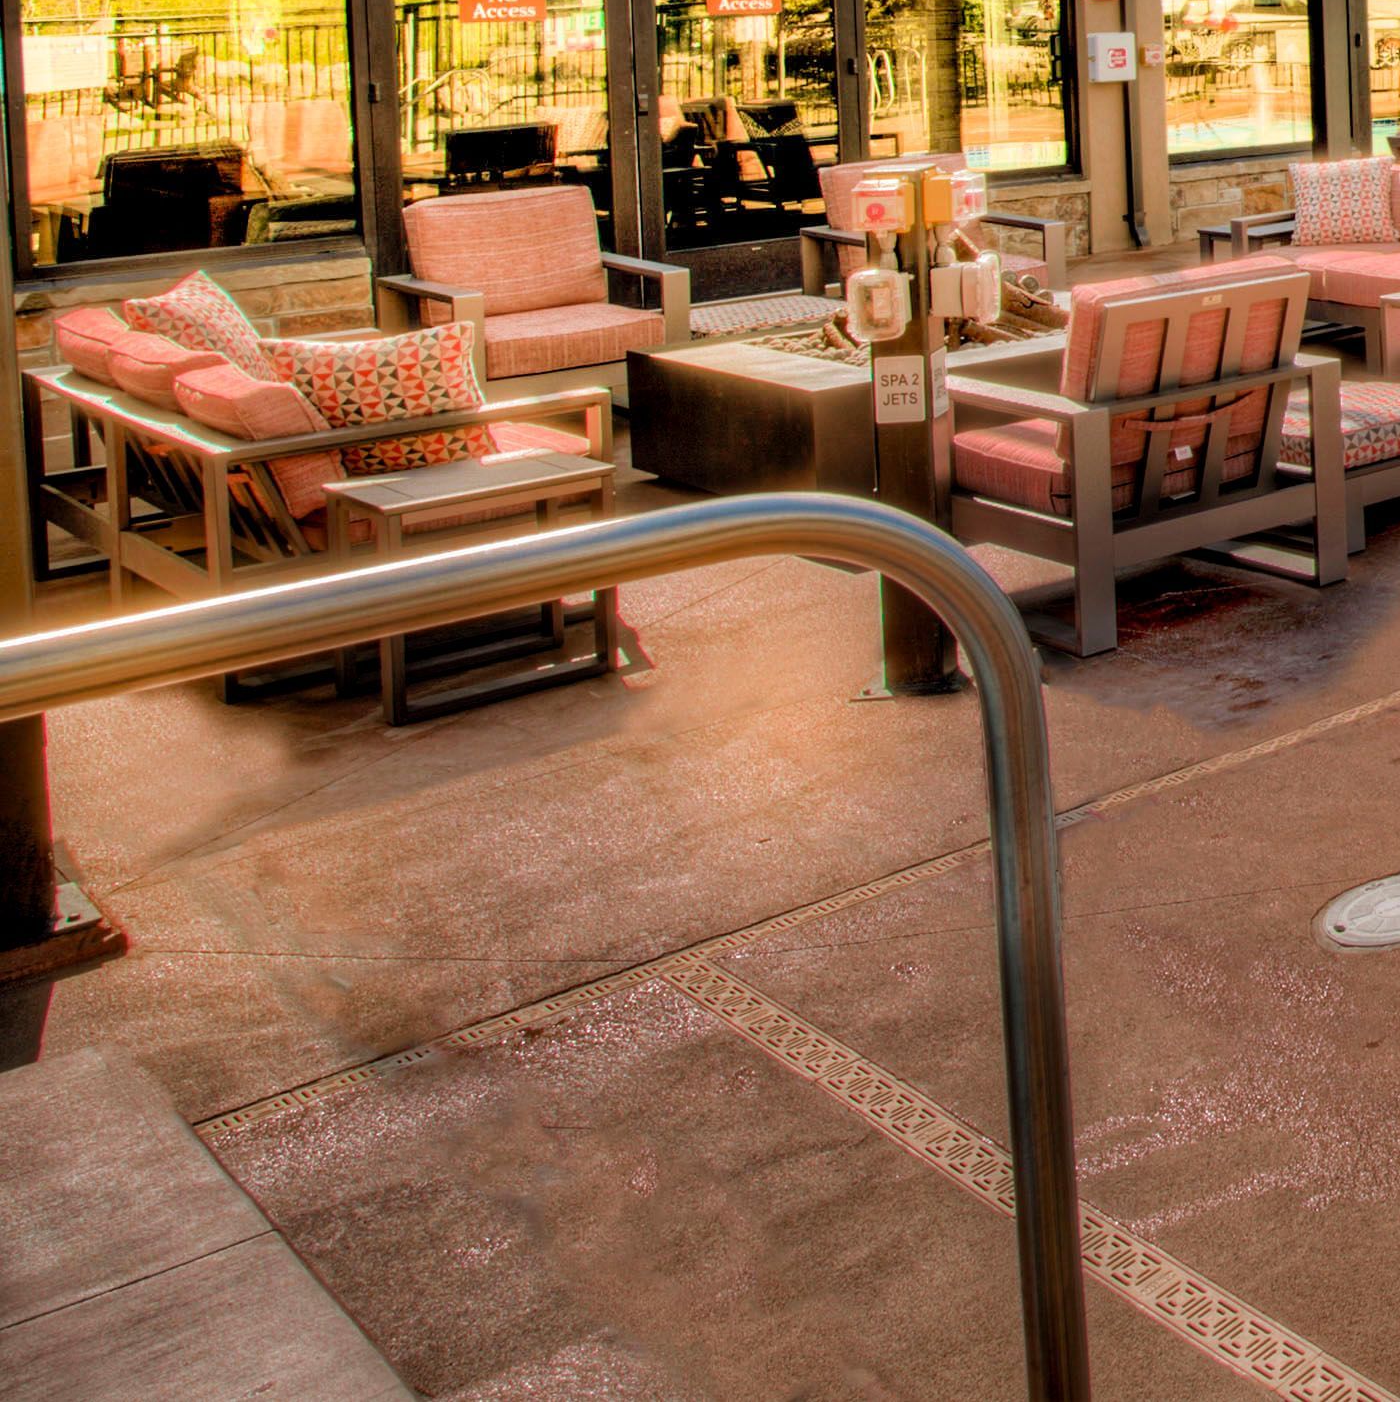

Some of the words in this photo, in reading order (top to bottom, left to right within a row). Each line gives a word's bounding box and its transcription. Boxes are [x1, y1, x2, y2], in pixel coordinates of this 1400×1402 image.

[473, 4, 537, 19] Access
[880, 374, 908, 387] SPA
[911, 373, 919, 386] 2
[882, 392, 918, 406] JETS
